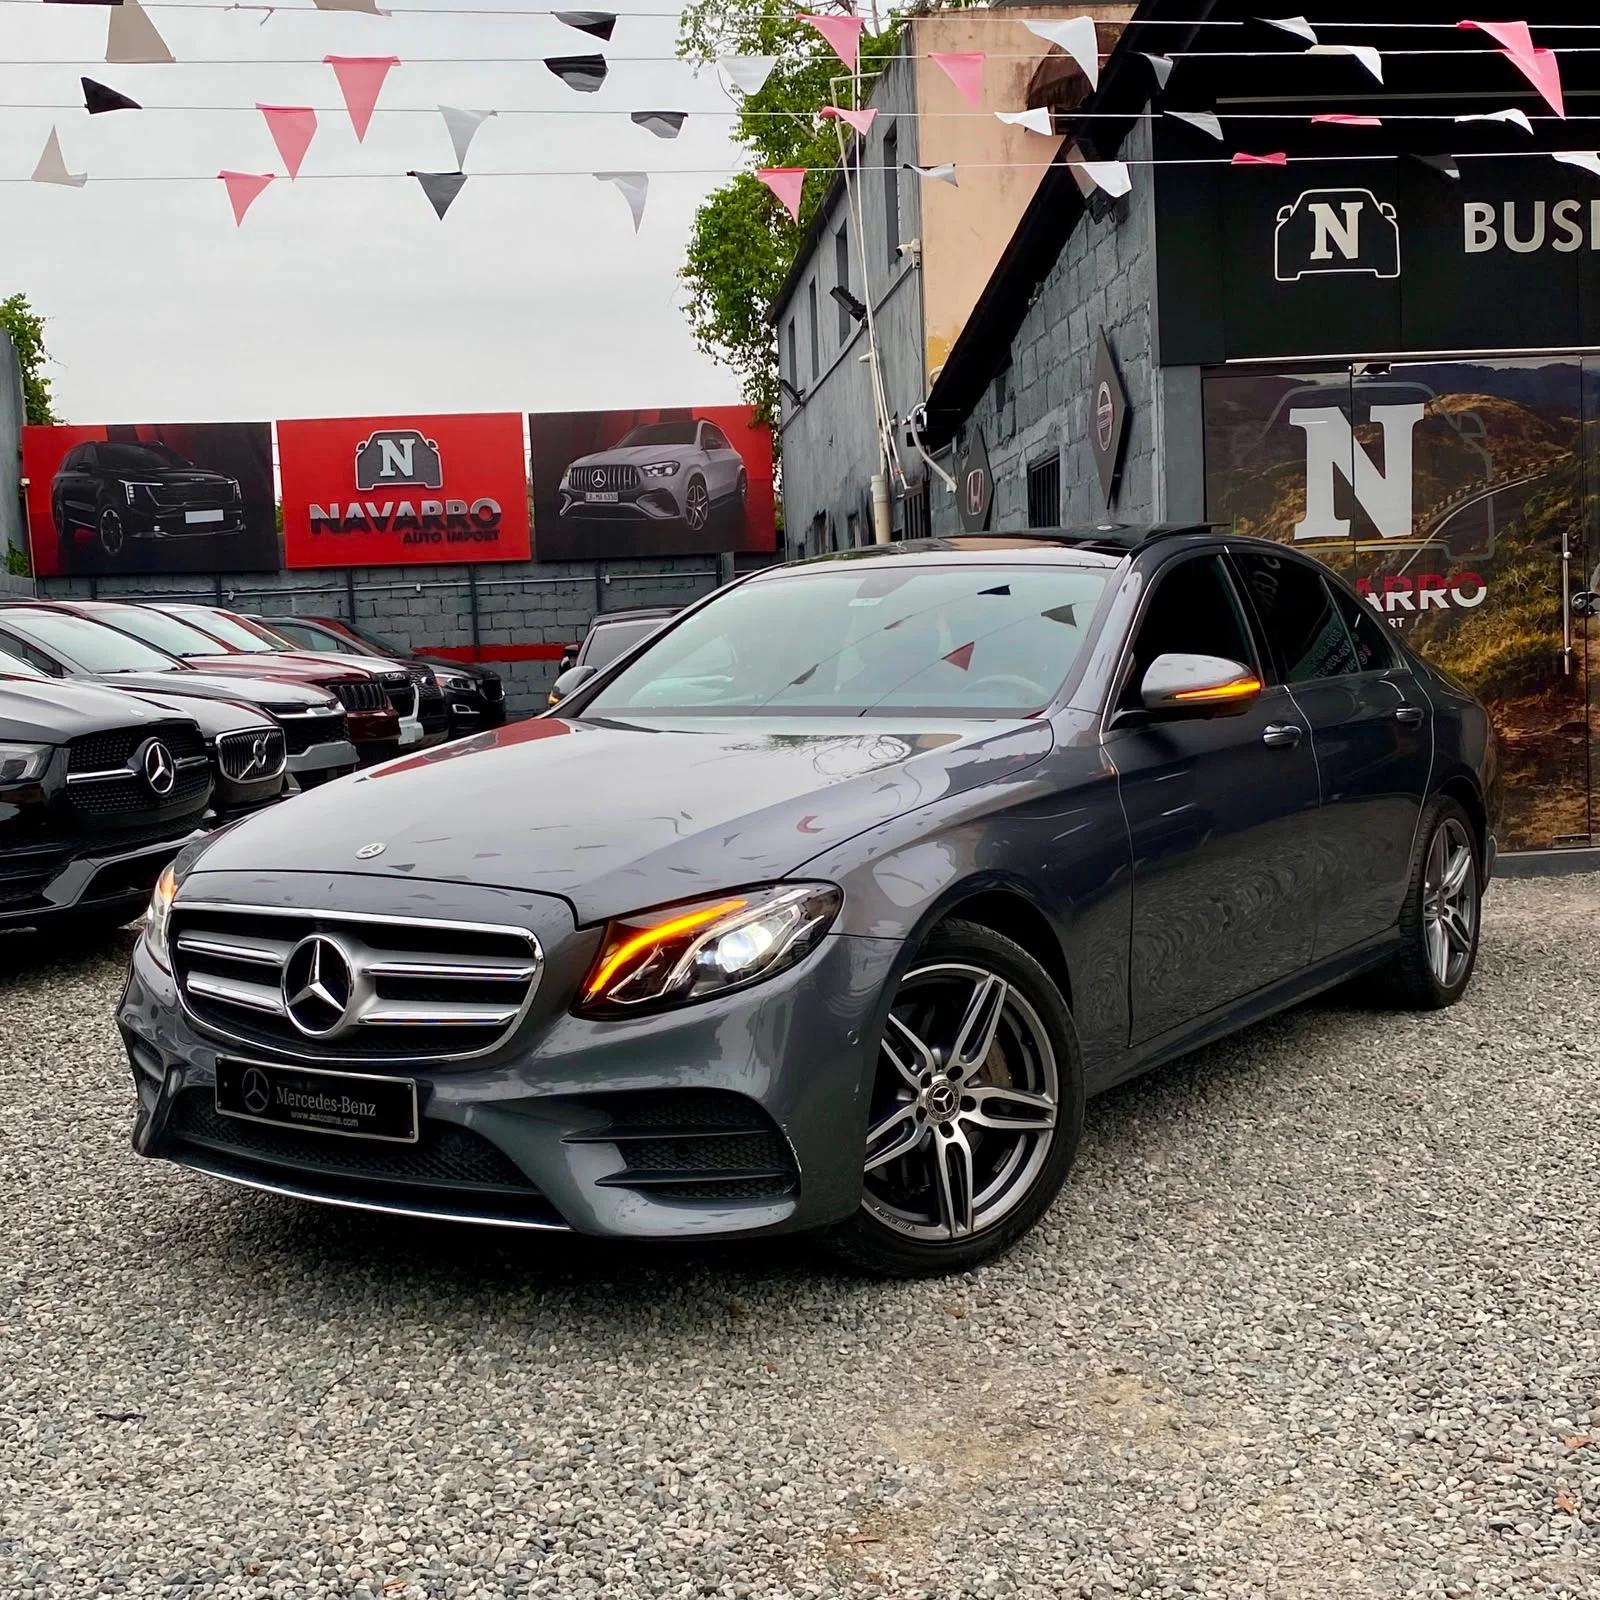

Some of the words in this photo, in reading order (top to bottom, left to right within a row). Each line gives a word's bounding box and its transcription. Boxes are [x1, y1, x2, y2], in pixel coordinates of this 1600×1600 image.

[1308, 202, 1364, 260] N
[378, 438, 415, 477] N
[1289, 403, 1425, 540] N
[309, 498, 502, 534] NAVARRO
[403, 530, 442, 544] AUTO
[447, 528, 500, 543] IMPORT
[1356, 572, 1487, 612] ARRO
[276, 1086, 377, 1117] Mercedes-Benz
